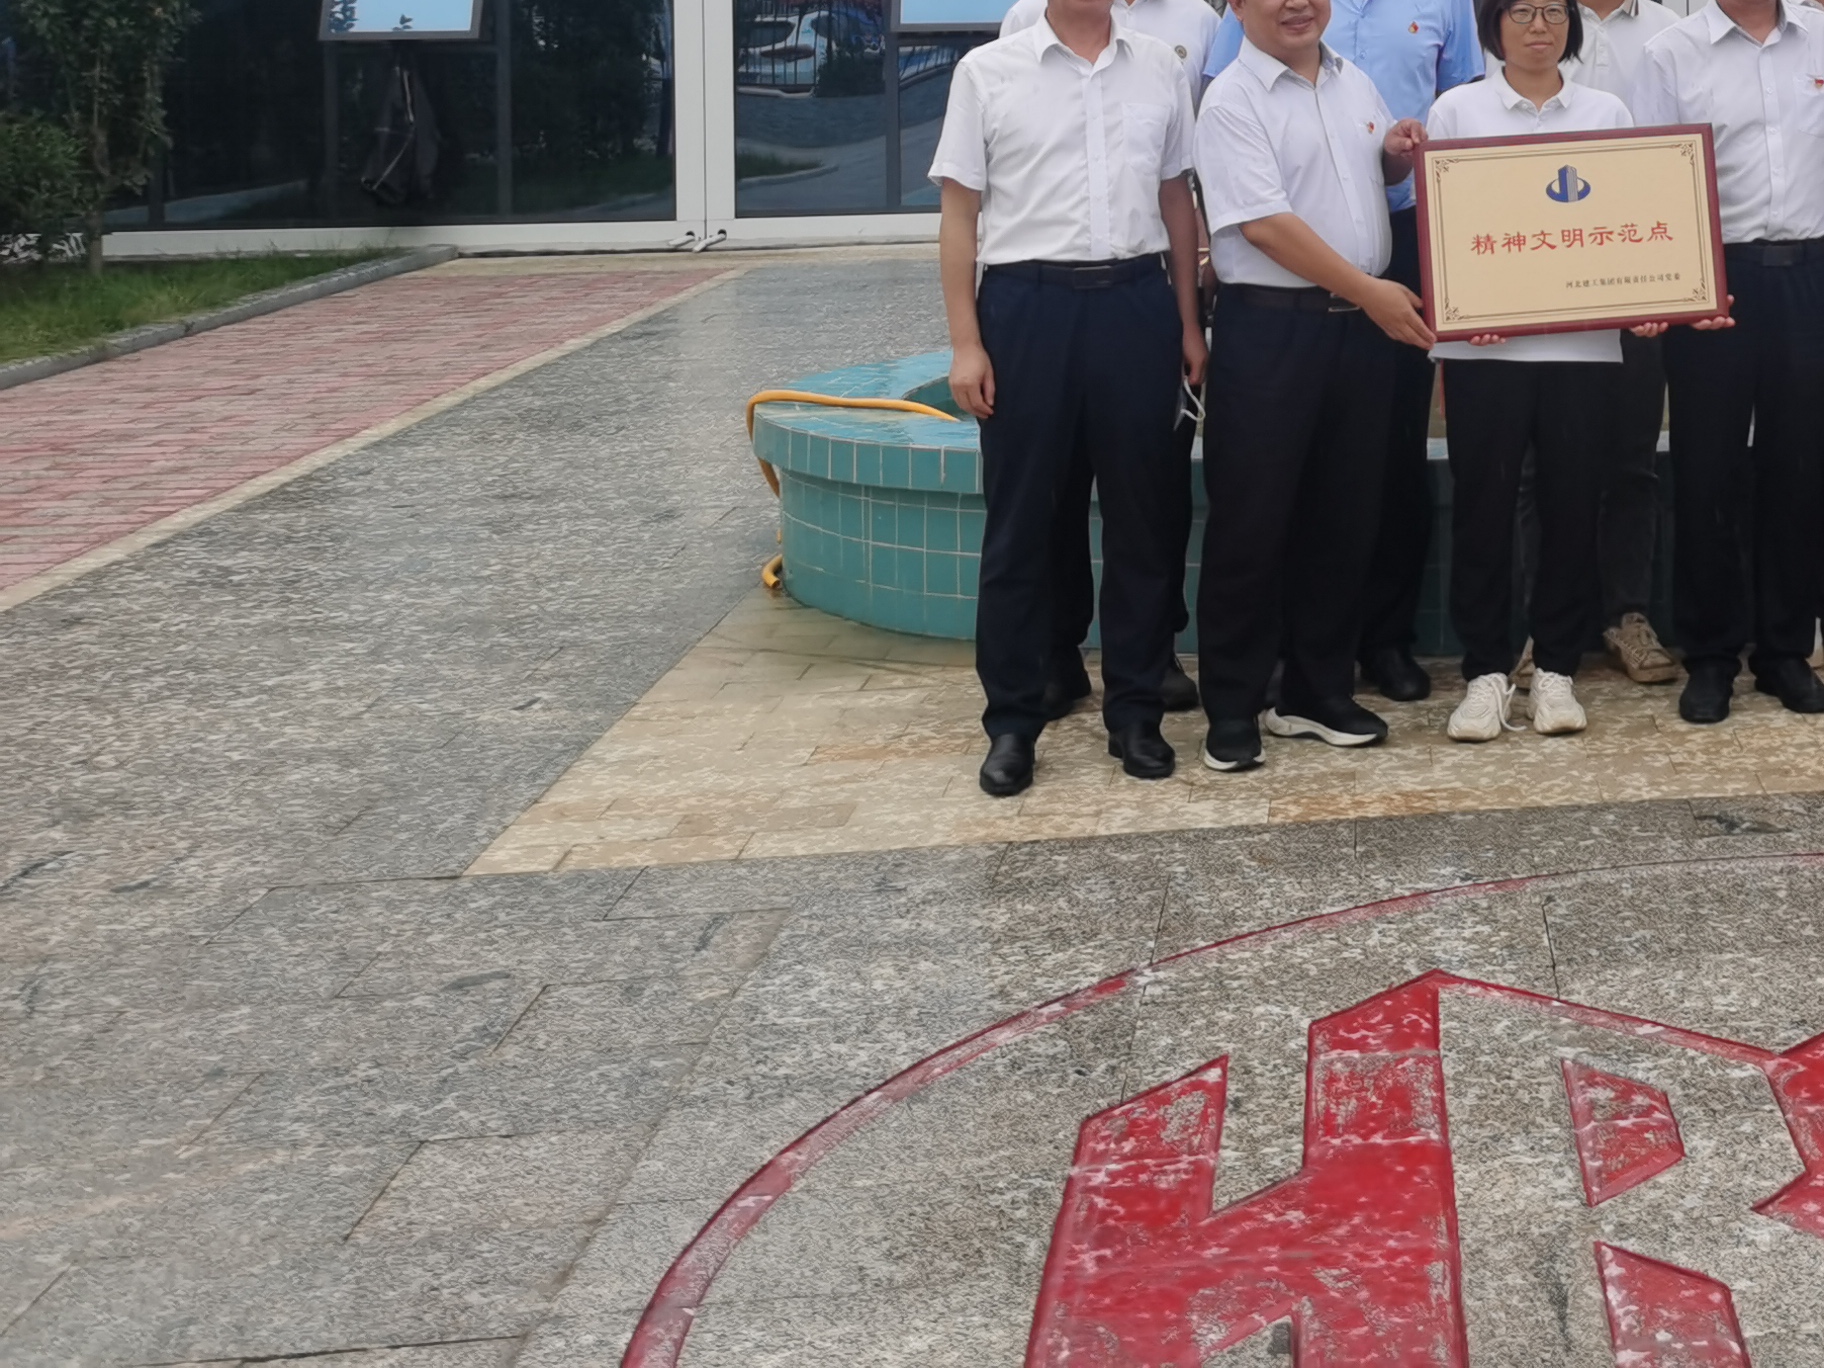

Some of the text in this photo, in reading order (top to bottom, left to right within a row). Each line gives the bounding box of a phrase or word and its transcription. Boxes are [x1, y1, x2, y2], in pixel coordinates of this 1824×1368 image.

[1471, 221, 1674, 256] 精神文明示范点
